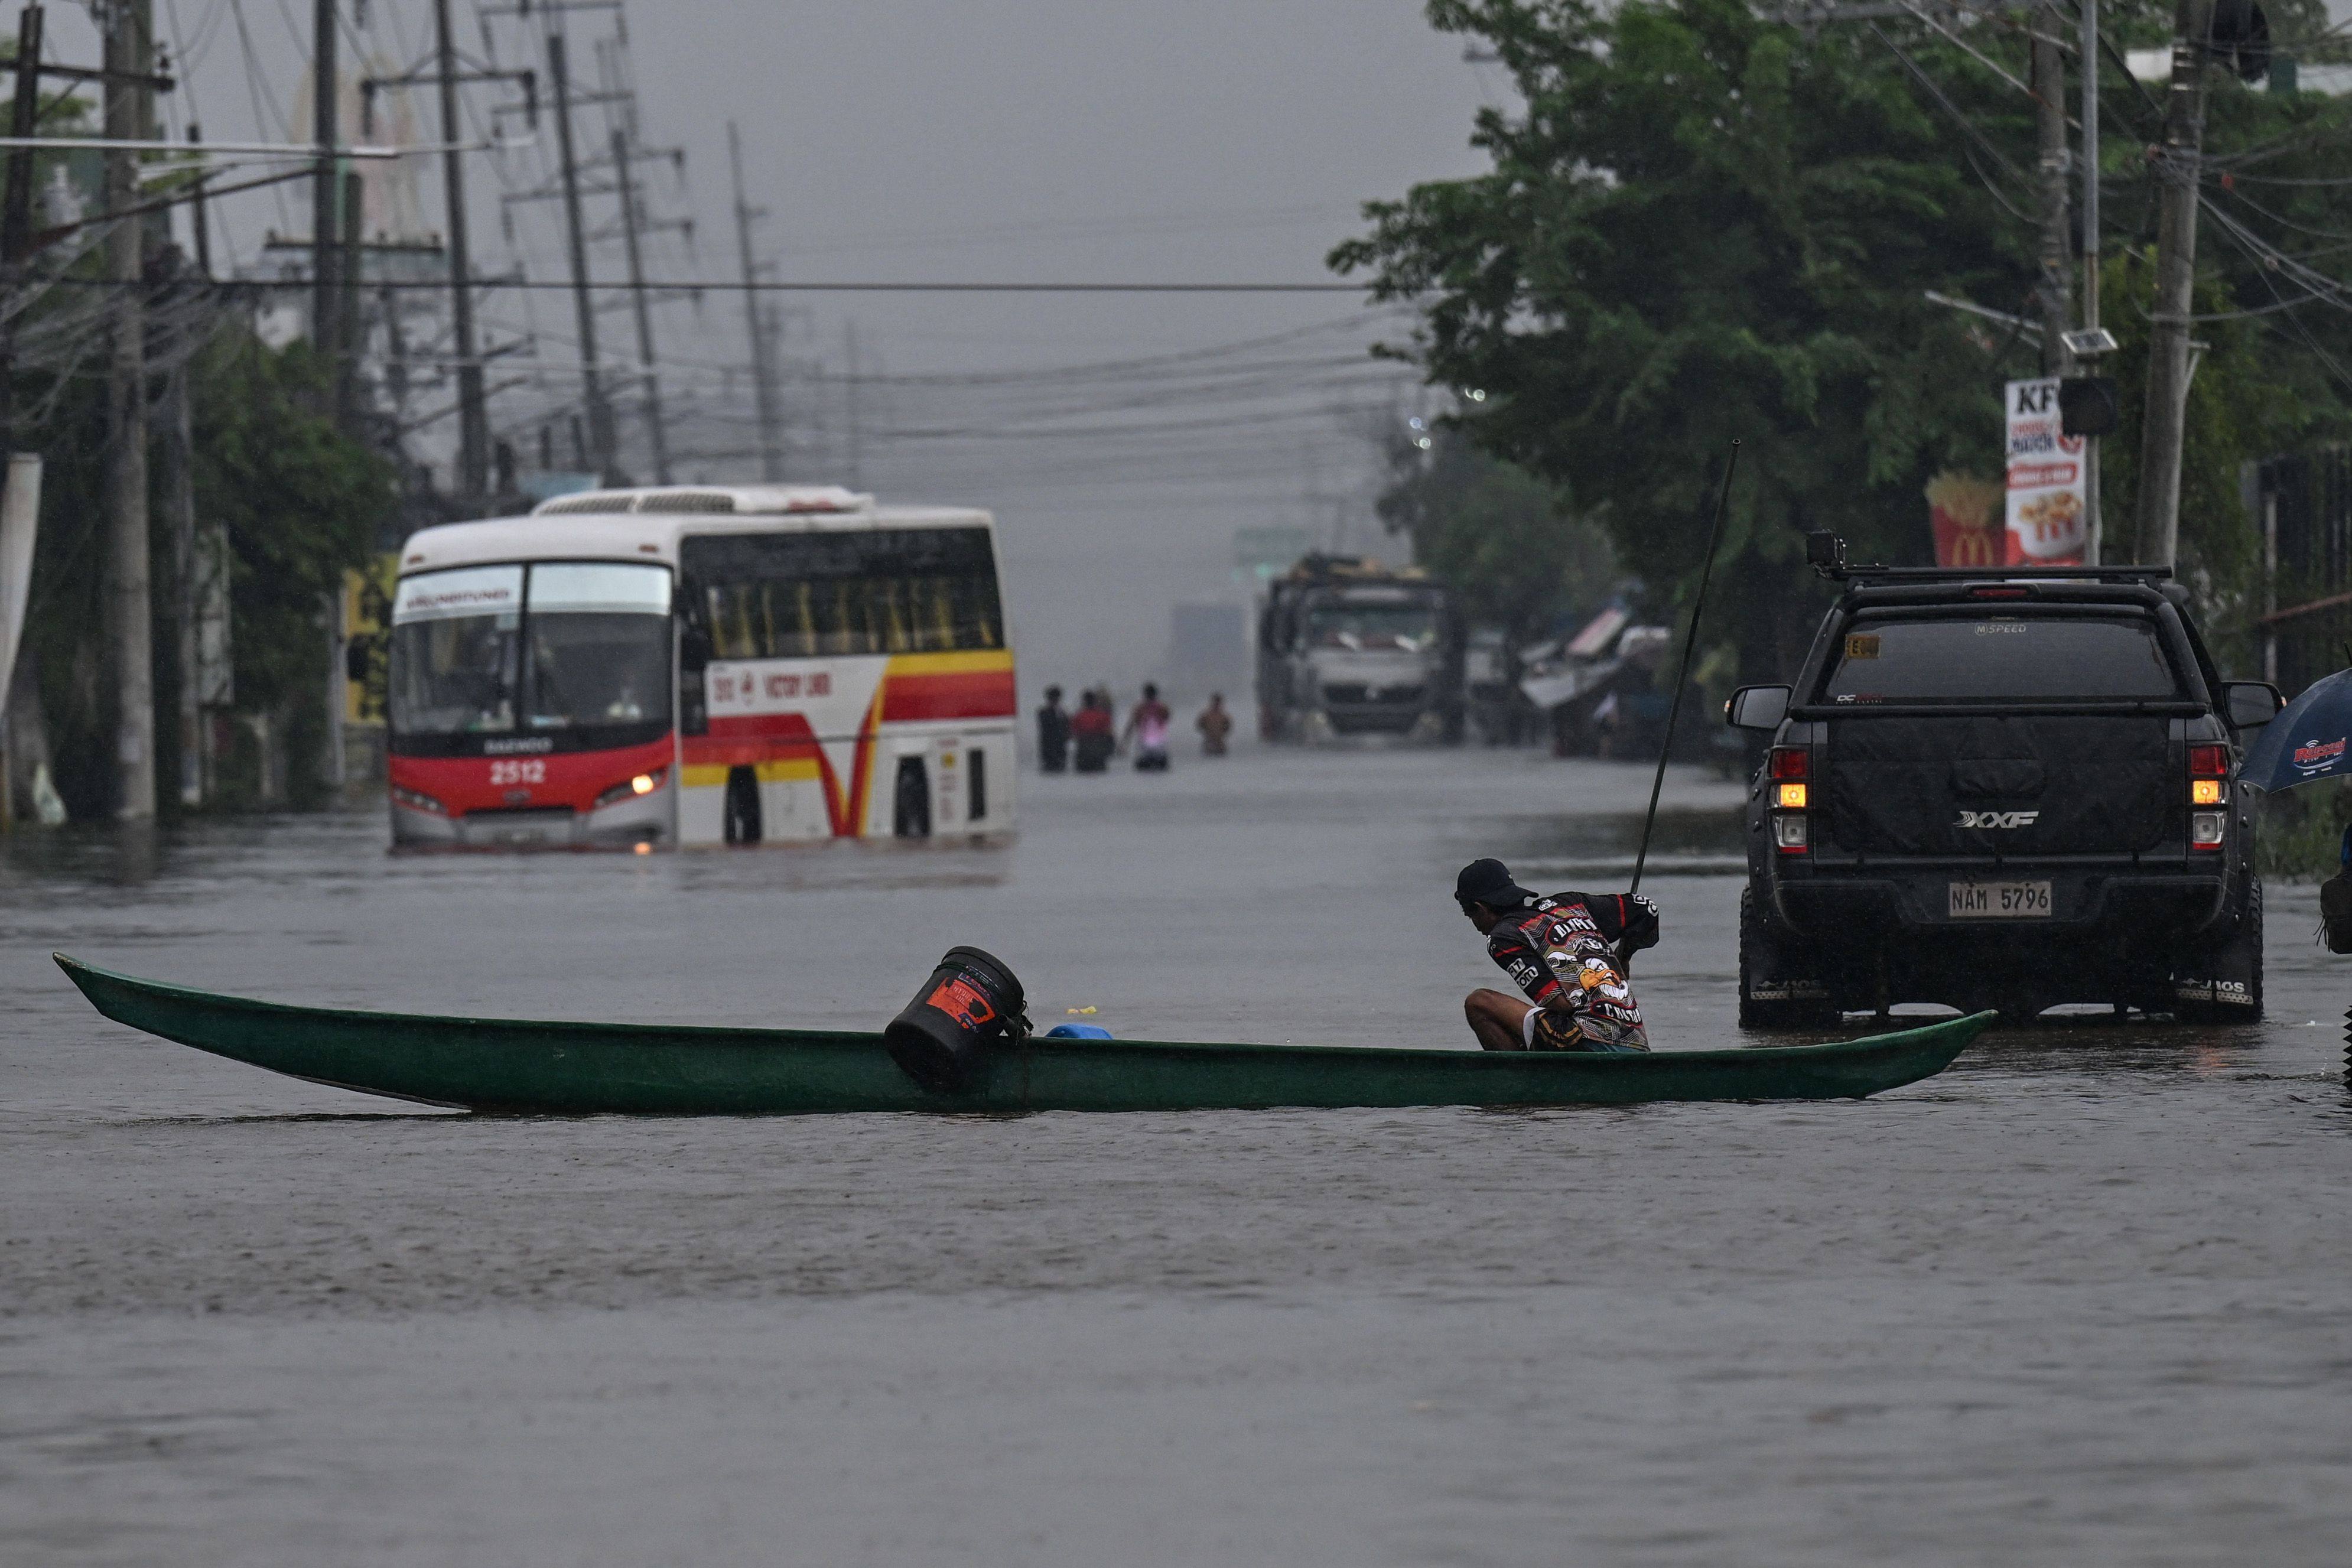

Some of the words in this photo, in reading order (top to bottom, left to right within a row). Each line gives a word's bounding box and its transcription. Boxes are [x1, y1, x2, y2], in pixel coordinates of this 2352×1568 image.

[2018, 384, 2055, 412] KF
[490, 759, 546, 785] 2512
[1952, 889, 1987, 910] NAM
[2001, 888, 2048, 910] 5796
